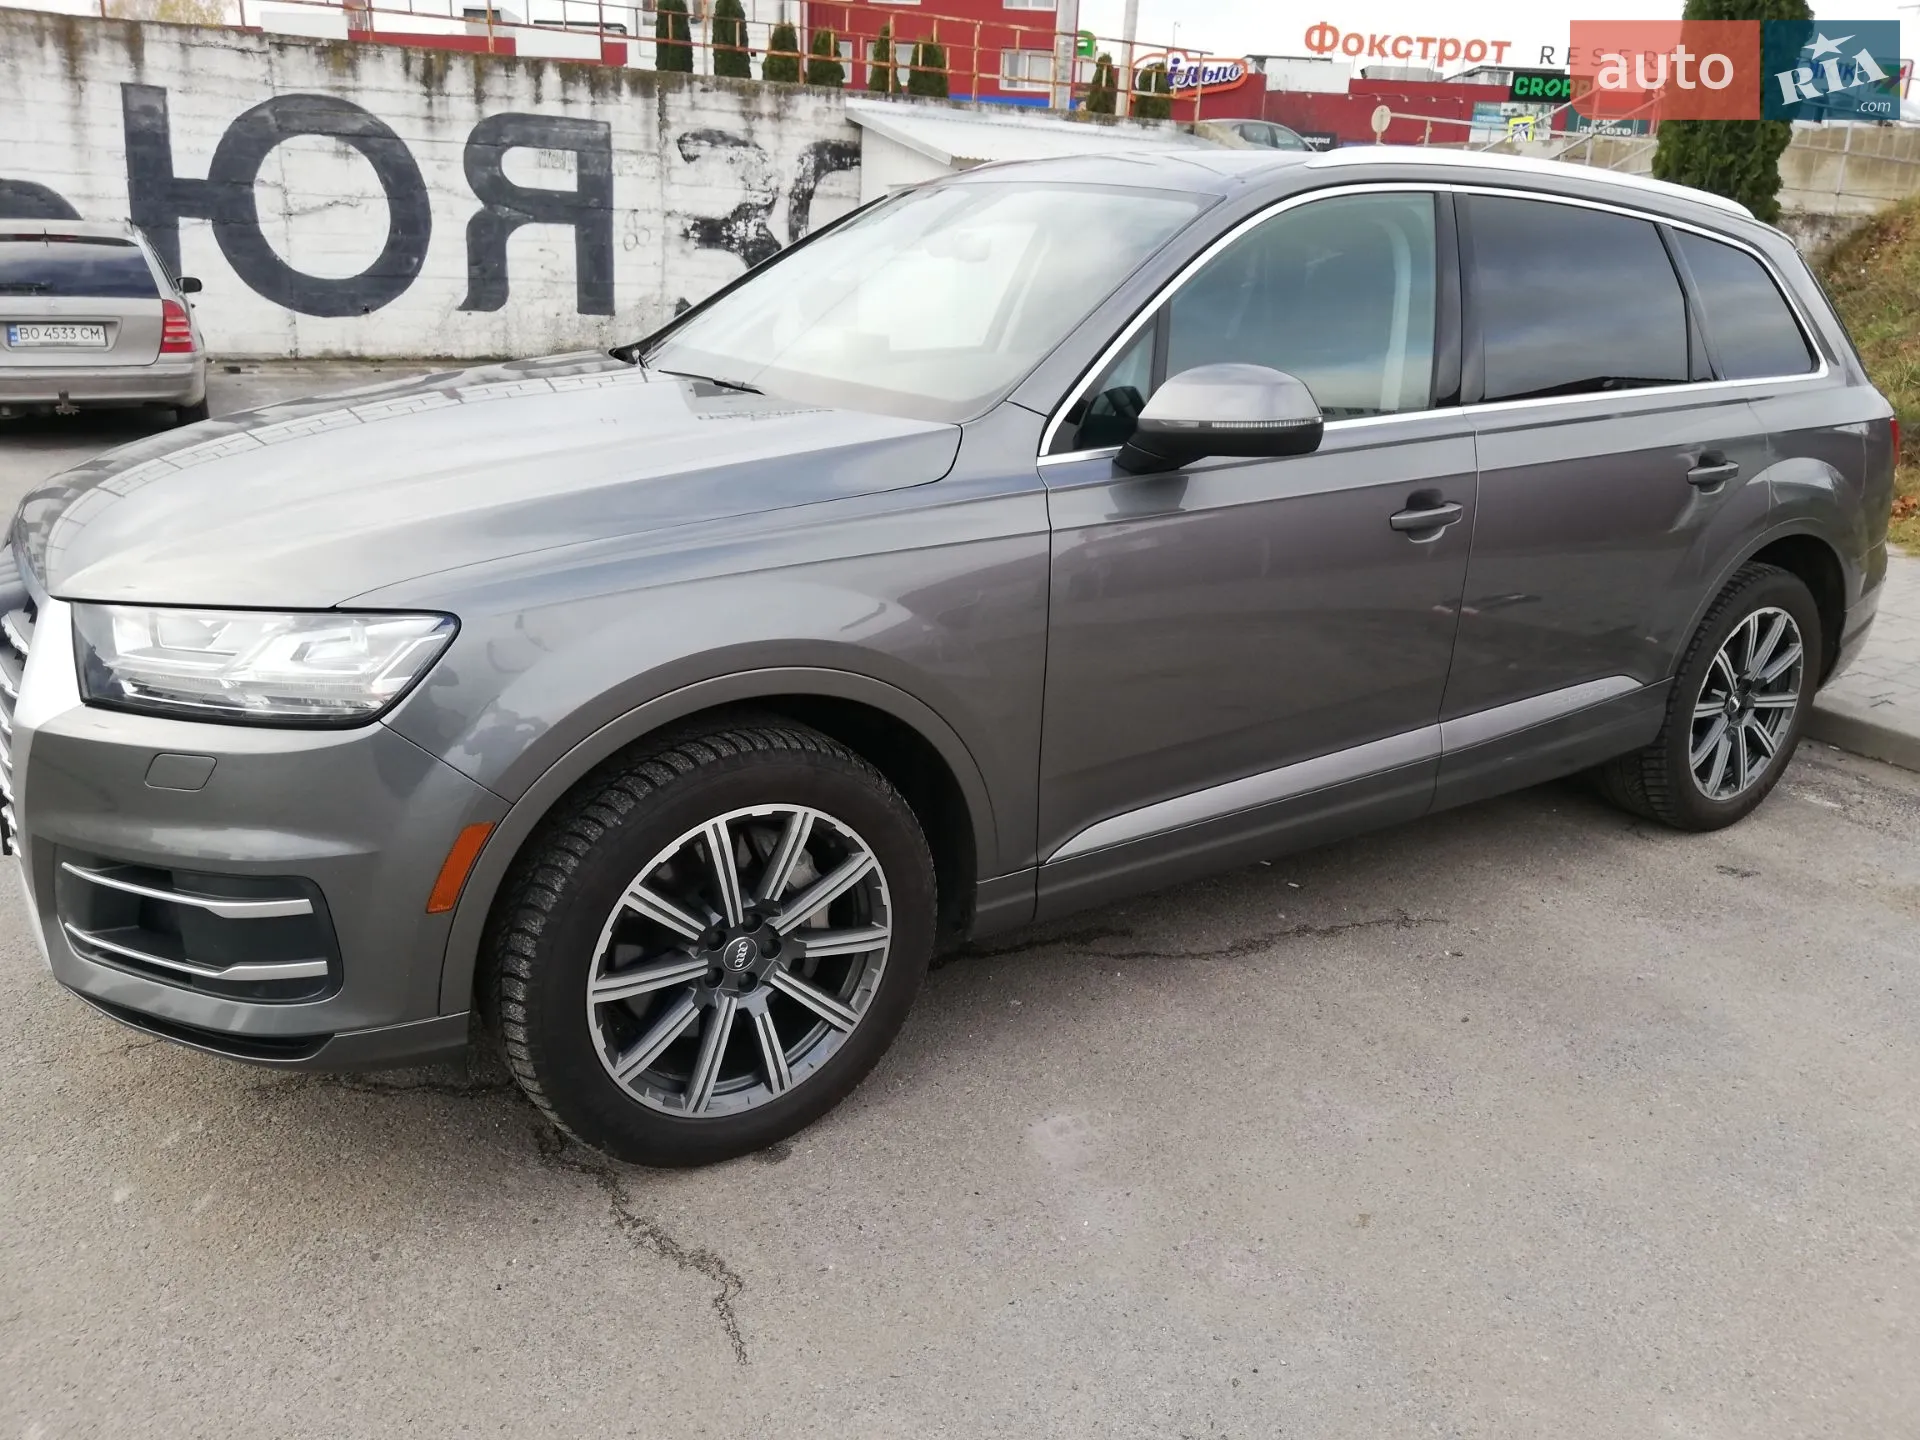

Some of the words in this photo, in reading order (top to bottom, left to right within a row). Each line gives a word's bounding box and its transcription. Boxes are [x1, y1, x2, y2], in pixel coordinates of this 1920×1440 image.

[1304, 22, 1512, 67] Фокстрот
[1539, 45, 1674, 71] RESER
[1136, 57, 1243, 90] ільпо
[44, 328, 77, 340] 4533
